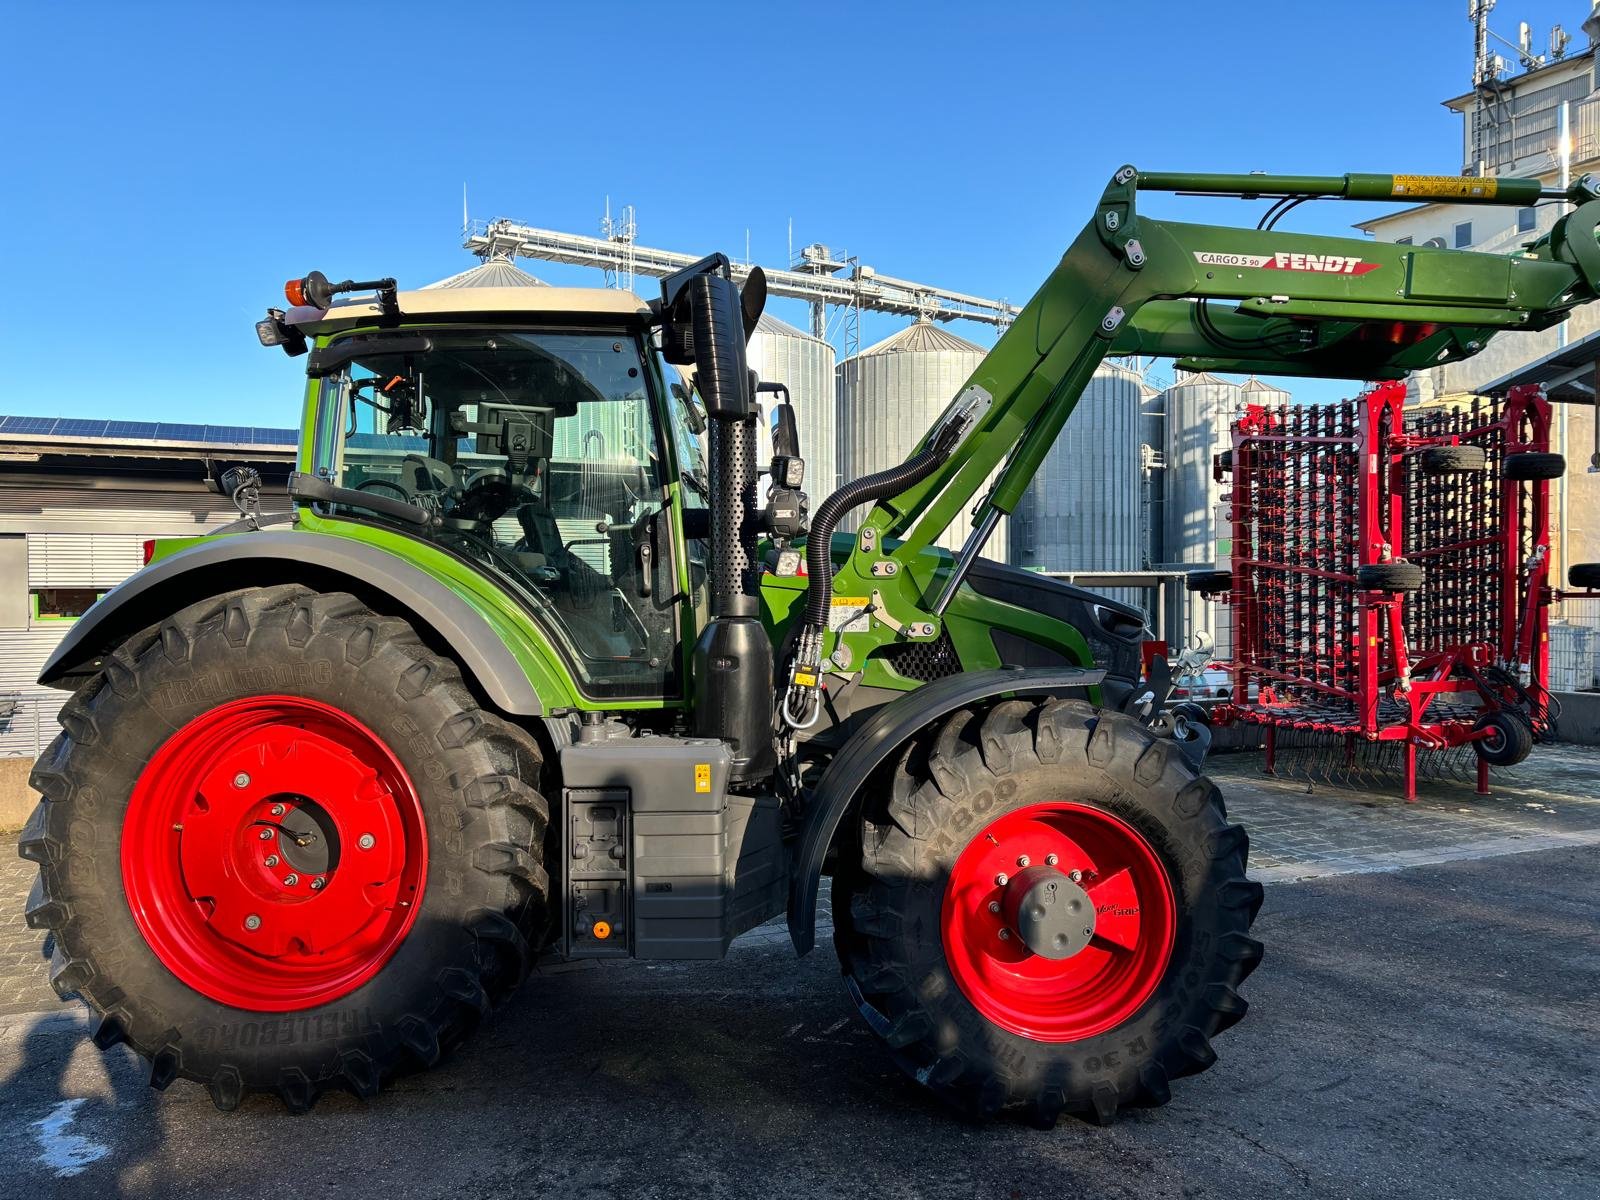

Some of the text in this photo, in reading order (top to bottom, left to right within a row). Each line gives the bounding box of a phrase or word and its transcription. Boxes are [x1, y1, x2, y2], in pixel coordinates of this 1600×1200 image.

[1201, 253, 1239, 265] CARGO
[1241, 256, 1248, 266] 5
[1275, 252, 1363, 273] FENDT
[950, 777, 1017, 832] 800
